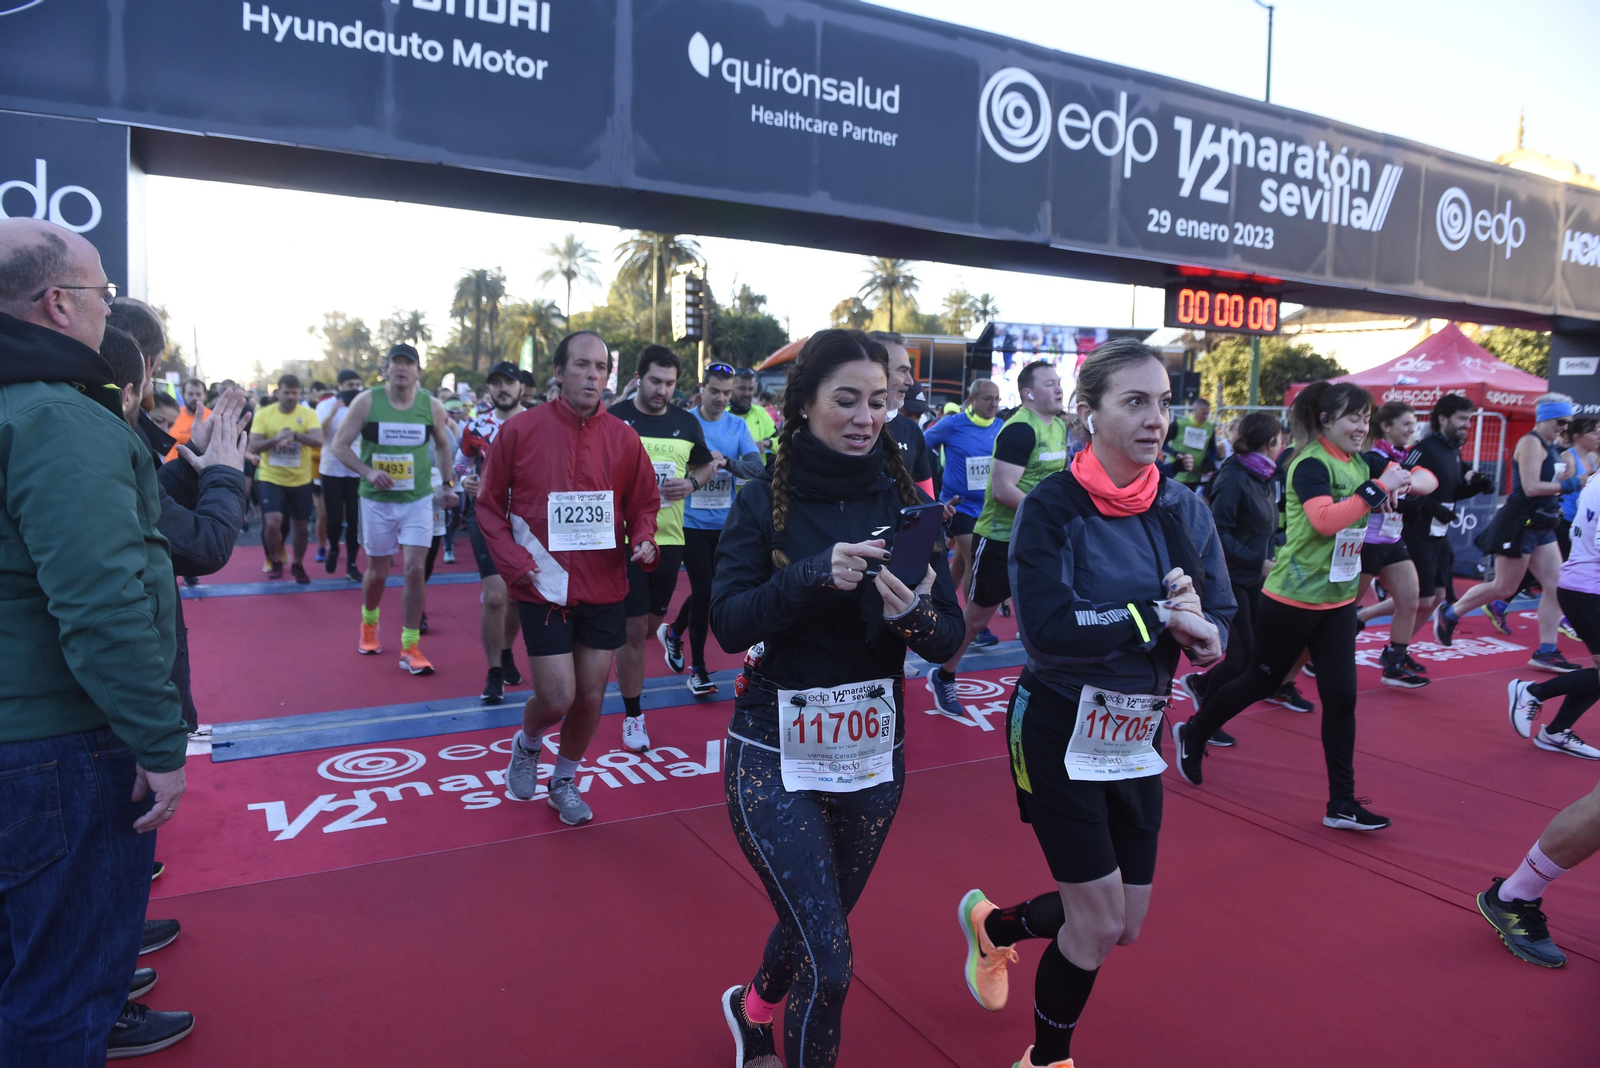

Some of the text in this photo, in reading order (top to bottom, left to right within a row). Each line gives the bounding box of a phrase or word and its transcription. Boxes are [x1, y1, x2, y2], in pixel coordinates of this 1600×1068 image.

[242, 2, 549, 80] Hyundauto Motor
[721, 57, 900, 114] quirónsalud
[751, 103, 899, 147] Healthcare Partner
[1057, 91, 1159, 179] edp
[1221, 126, 1371, 193] maratón
[1259, 177, 1372, 231] sevilla
[1147, 208, 1275, 250] 29 enero 2023
[1473, 199, 1526, 260] edp
[1178, 288, 1277, 331] 00 00 00
[554, 505, 604, 524] 12239
[1449, 506, 1478, 535] dp
[792, 706, 880, 744] 11706
[1086, 709, 1152, 742] 11705
